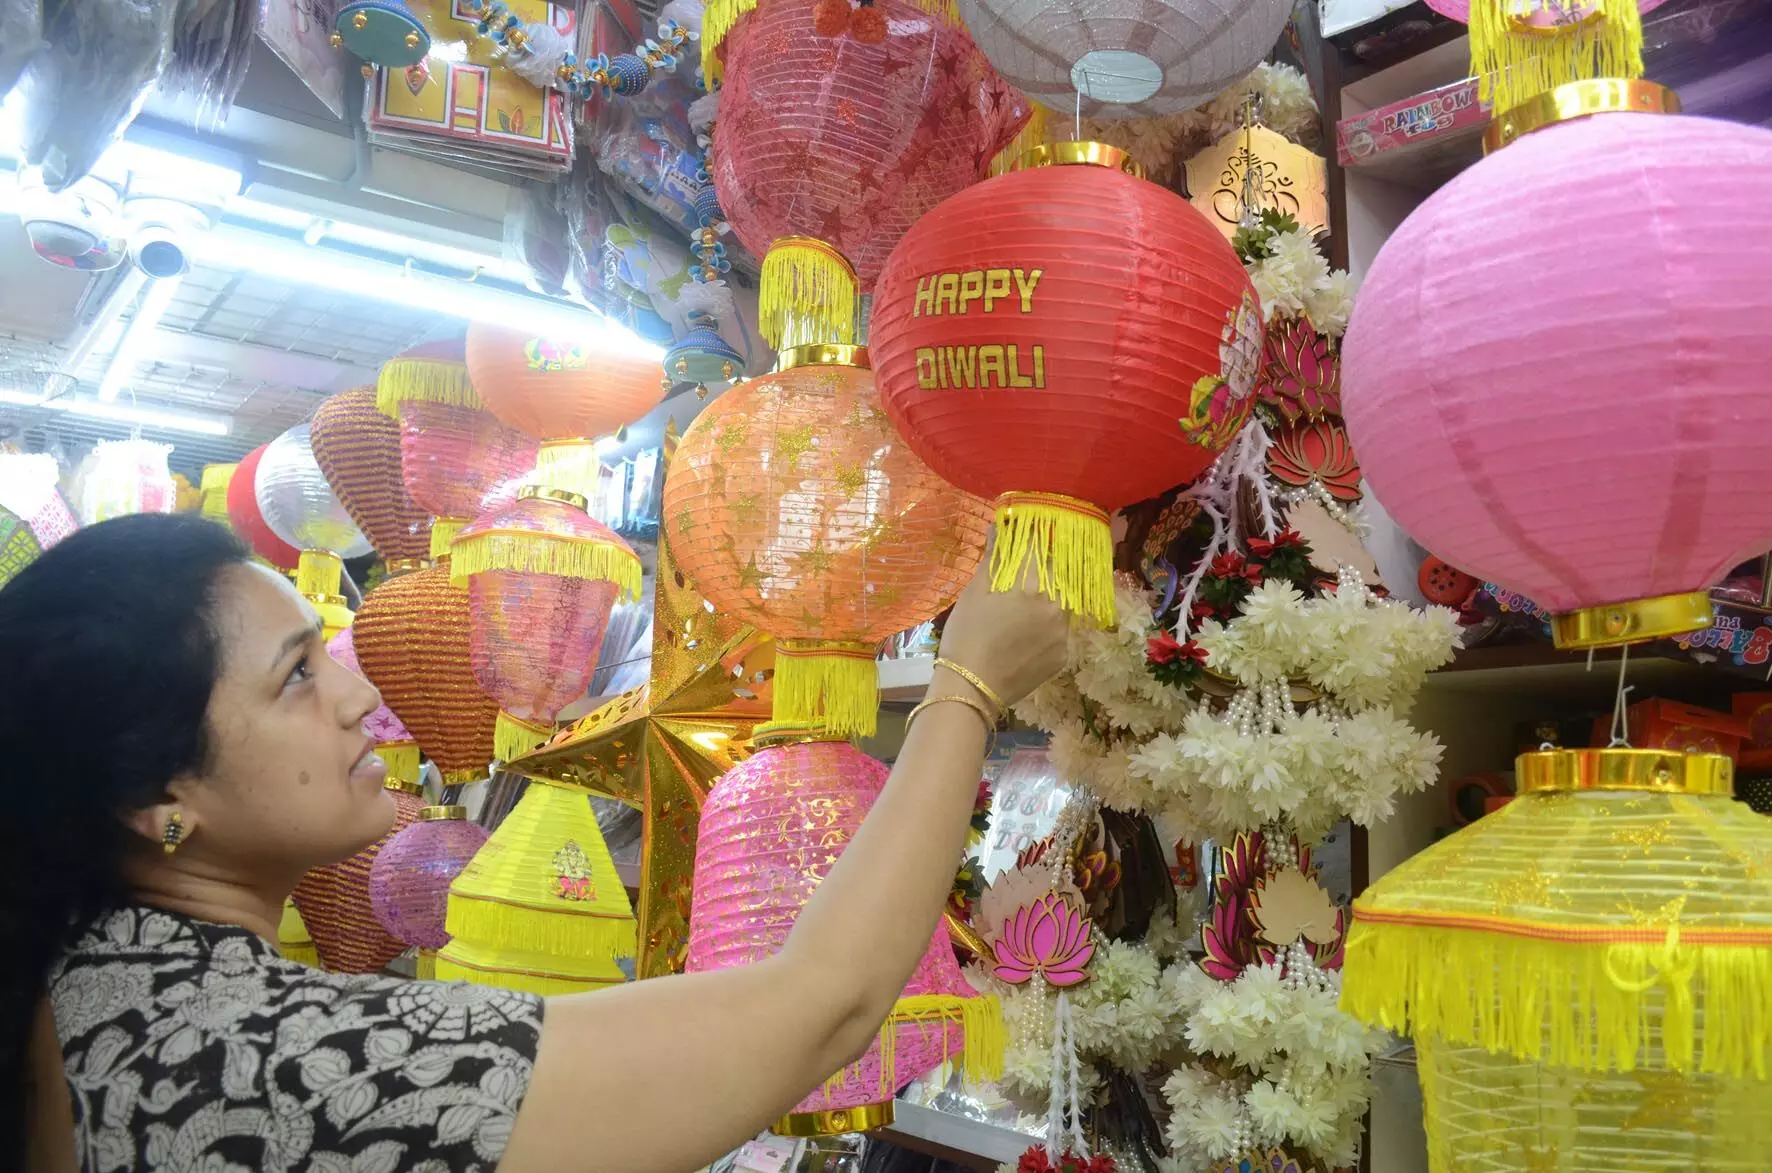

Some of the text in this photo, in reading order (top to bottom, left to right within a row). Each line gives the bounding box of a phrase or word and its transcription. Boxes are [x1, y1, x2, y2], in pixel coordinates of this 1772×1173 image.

[1382, 89, 1473, 135] RAINBOW
[913, 268, 1044, 317] HAPPY
[916, 345, 1045, 389] DIWALI
